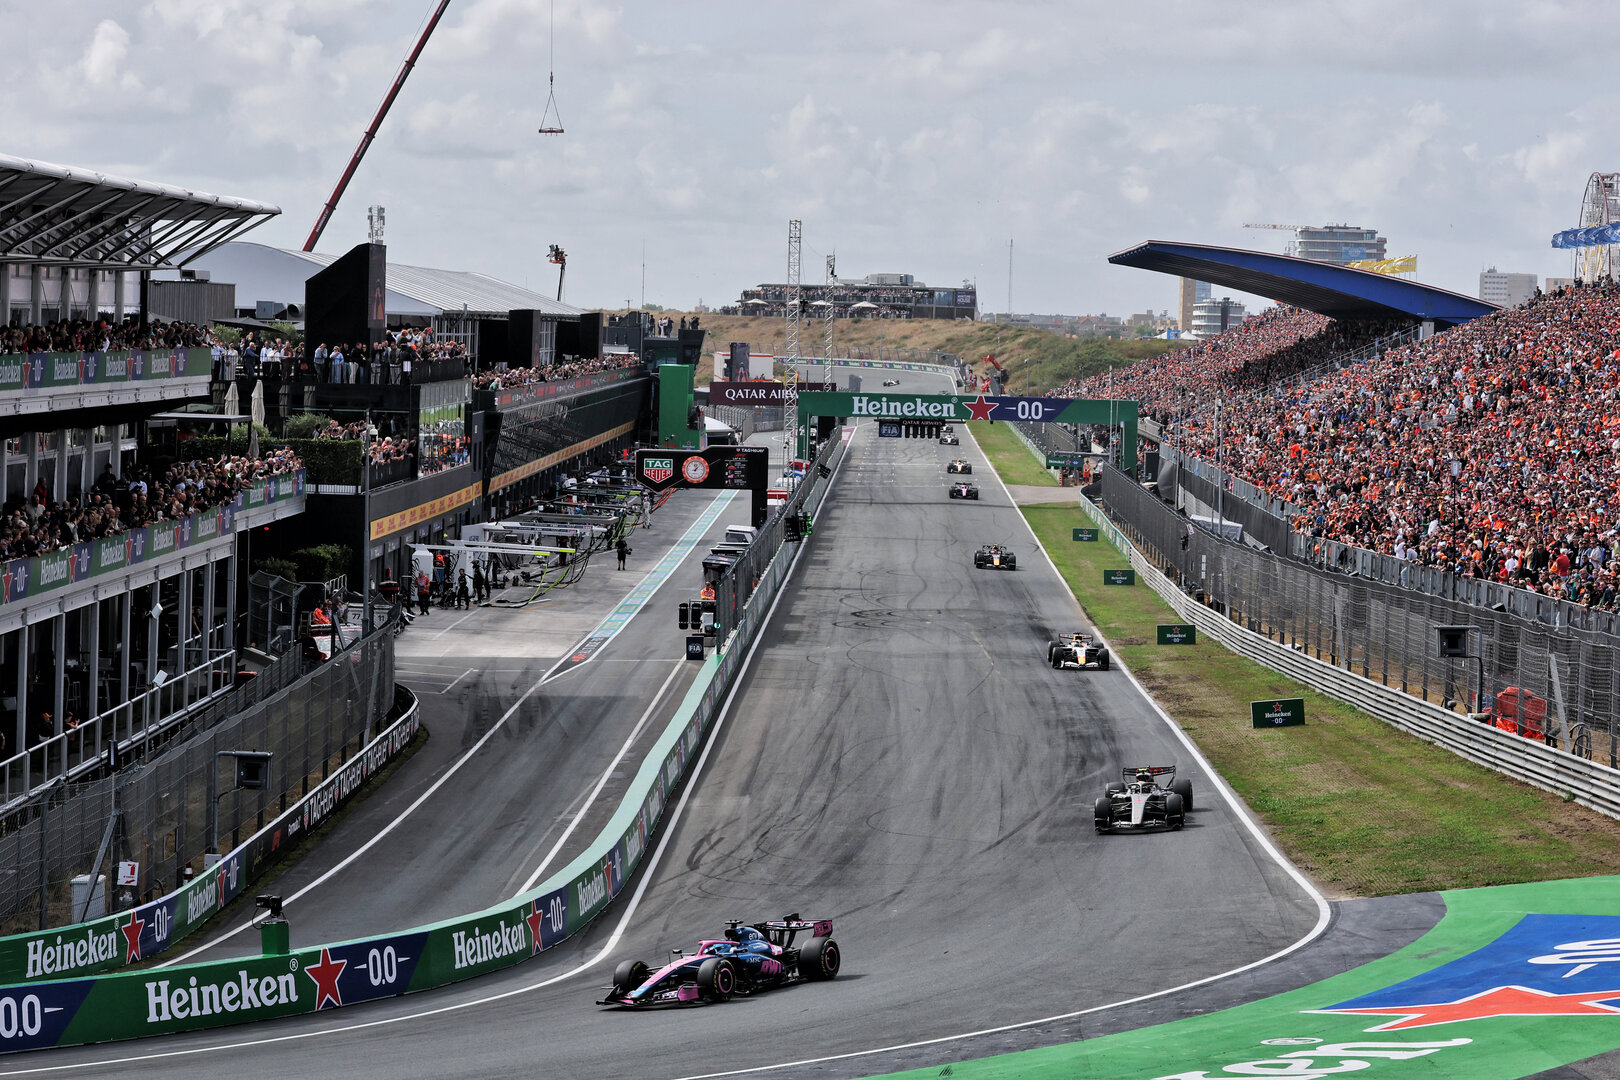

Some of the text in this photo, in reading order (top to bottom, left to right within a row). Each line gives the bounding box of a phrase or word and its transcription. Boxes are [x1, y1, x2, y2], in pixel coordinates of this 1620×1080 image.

[0, 359, 21, 383] eineken
[725, 388, 766, 400] QATAR
[852, 396, 1043, 420] Heineken 0.0
[881, 425, 898, 435] FIA
[645, 468, 672, 482] HEUER
[646, 460, 671, 468] TAG
[100, 538, 124, 567] Heineken
[40, 556, 67, 585] Heineken
[187, 879, 216, 925] Heineken
[577, 870, 605, 916] Heineken
[26, 906, 168, 978] Heineken 0.0
[453, 896, 562, 969] Heineken 0.0
[145, 945, 397, 1022] Heineken 0.0
[0, 994, 41, 1038] 0.0
